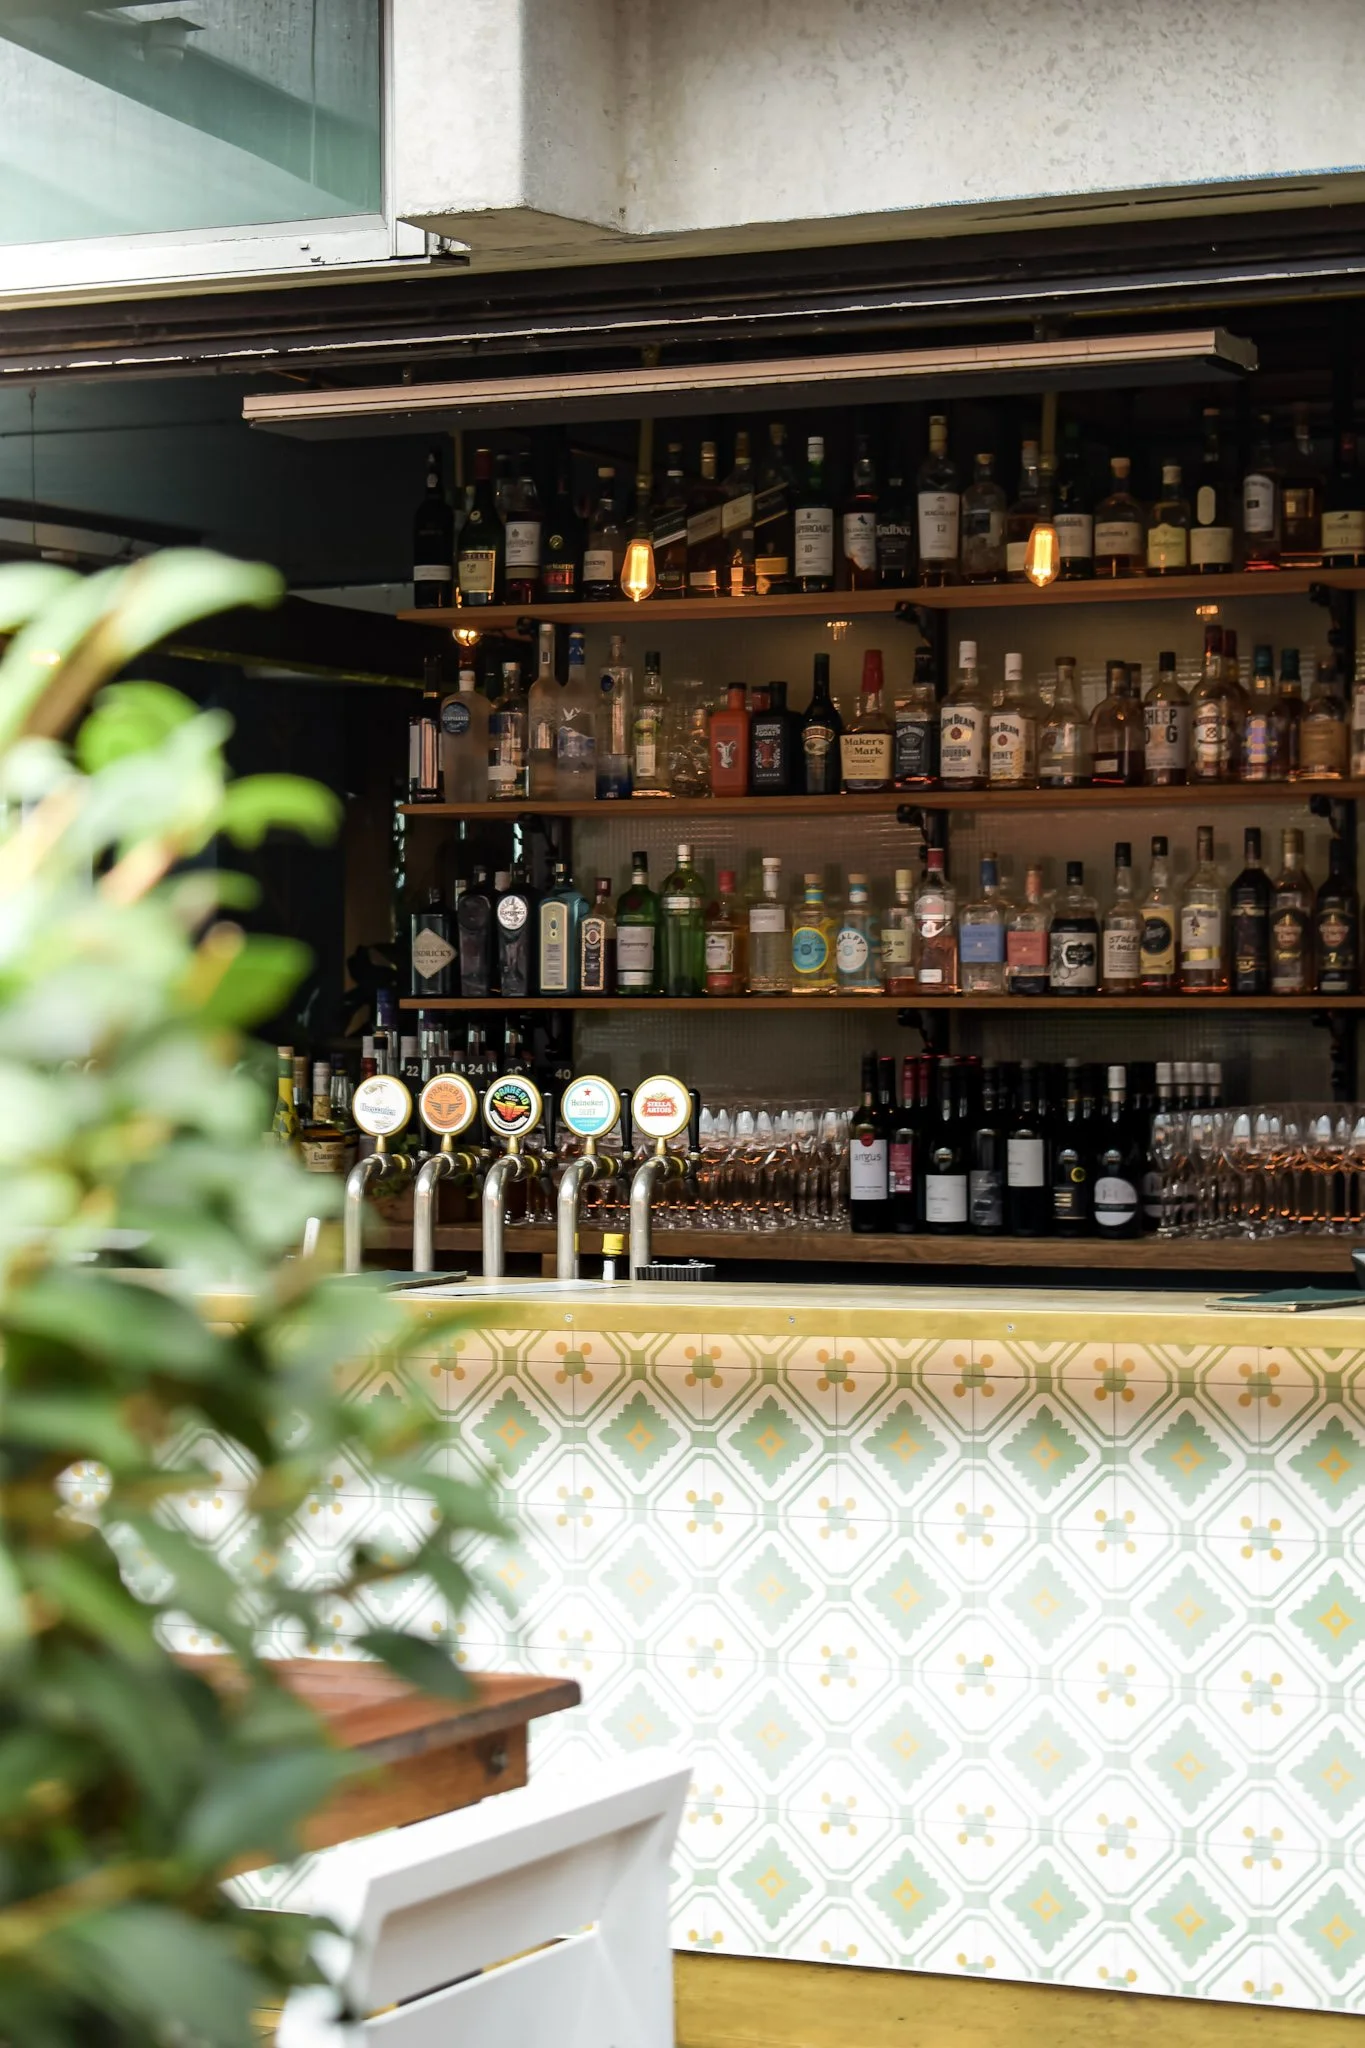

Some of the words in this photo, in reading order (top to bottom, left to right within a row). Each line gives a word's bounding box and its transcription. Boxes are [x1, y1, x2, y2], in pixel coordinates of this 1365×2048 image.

[953, 713, 976, 731] BEAM
[844, 738, 885, 746] Maker's
[854, 747, 884, 755] Mark
[406, 1065, 419, 1077] 22
[435, 1064, 446, 1075] 11
[467, 1063, 484, 1075] 24
[555, 1068, 571, 1080] 40
[428, 1083, 463, 1102] PANHEAD
[494, 1084, 530, 1105] PANHEAD
[571, 1099, 604, 1107] Heineken
